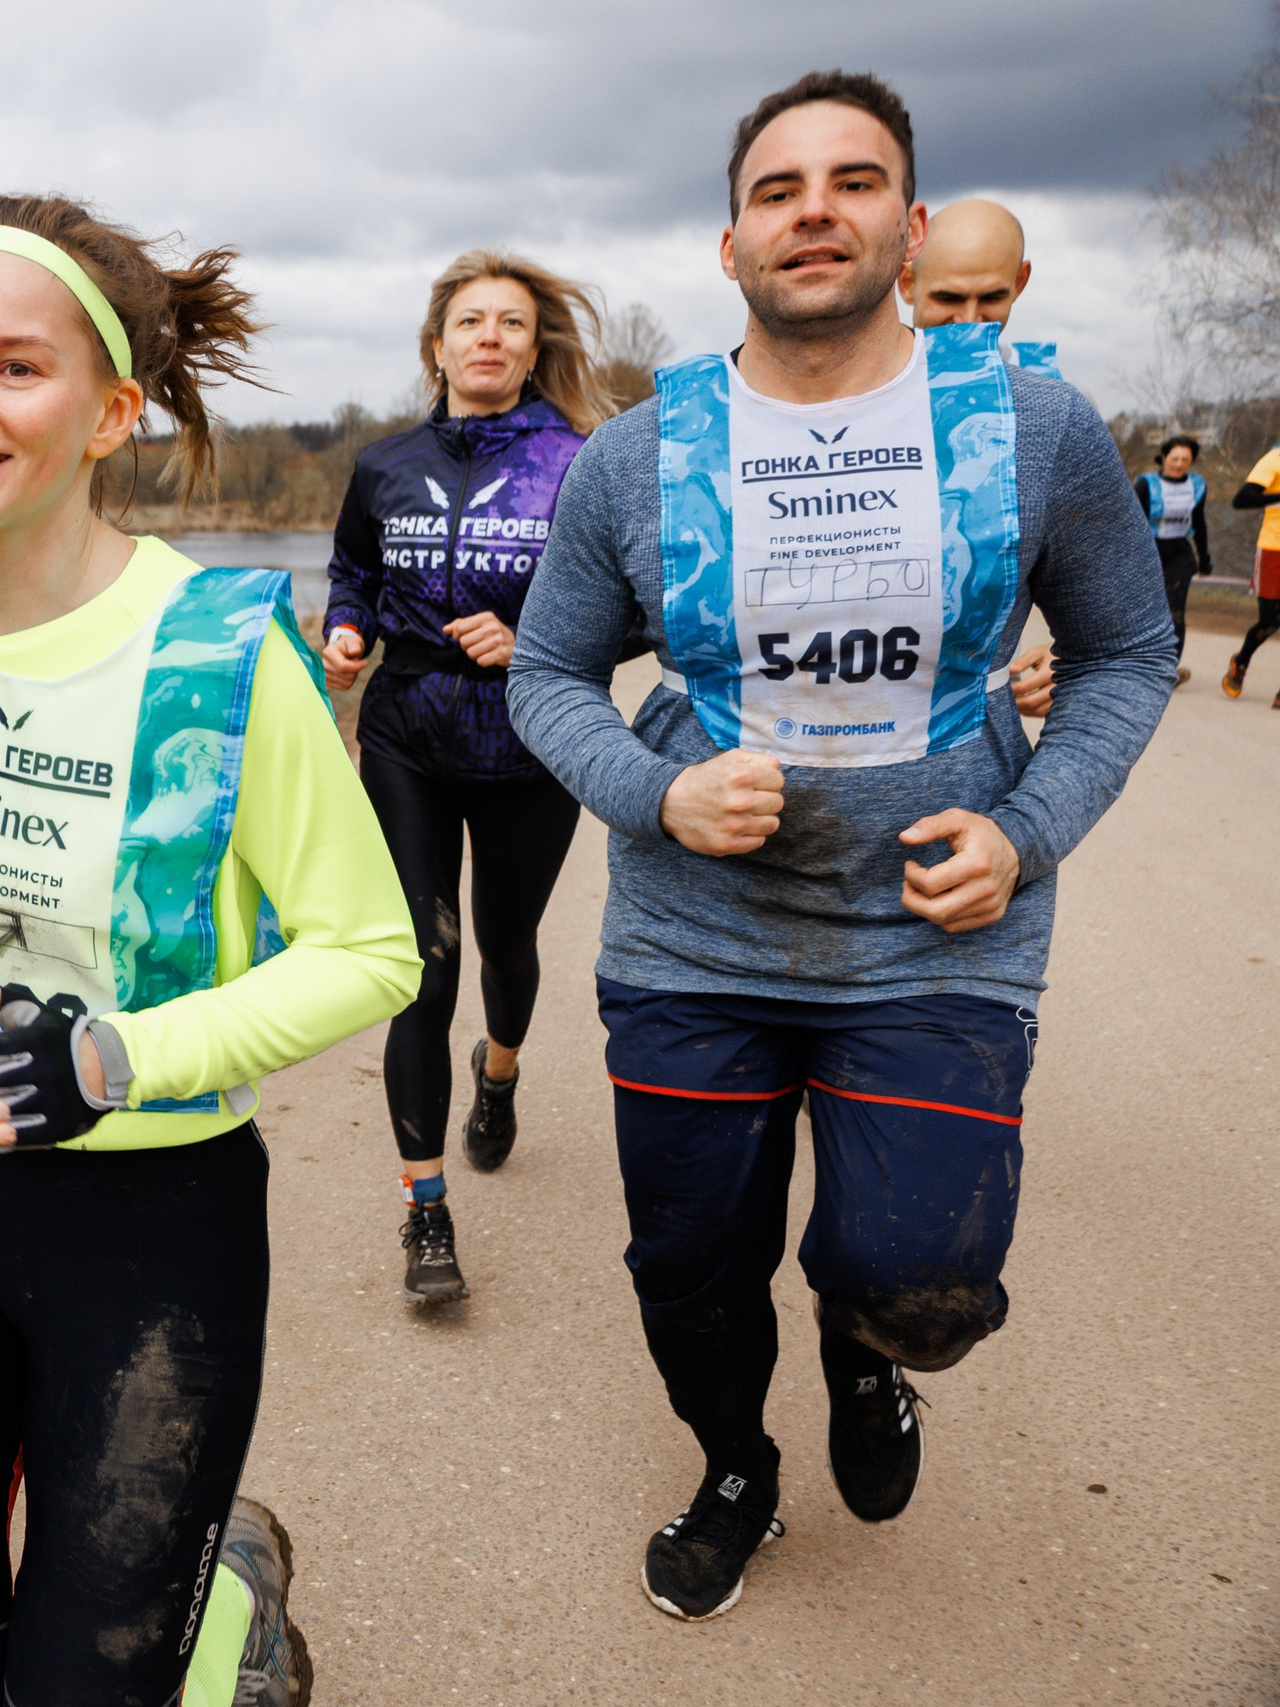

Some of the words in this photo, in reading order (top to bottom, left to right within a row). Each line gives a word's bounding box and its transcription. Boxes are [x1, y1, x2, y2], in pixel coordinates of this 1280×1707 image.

[742, 455, 820, 477] ГОНКА
[828, 447, 922, 469] ГЕРОЕВ
[768, 488, 899, 520] Sminex
[459, 517, 550, 540] ГЕРОЕВ
[770, 526, 901, 545] ПЕРФЕКЦИОНИСТЫ
[770, 551, 799, 560] FINE
[805, 541, 901, 558] DEVELOPMENT
[758, 626, 920, 684] 5406
[802, 721, 895, 736] ГАЗПРОМБАНК
[5, 745, 113, 787] ГЕРОЕВ
